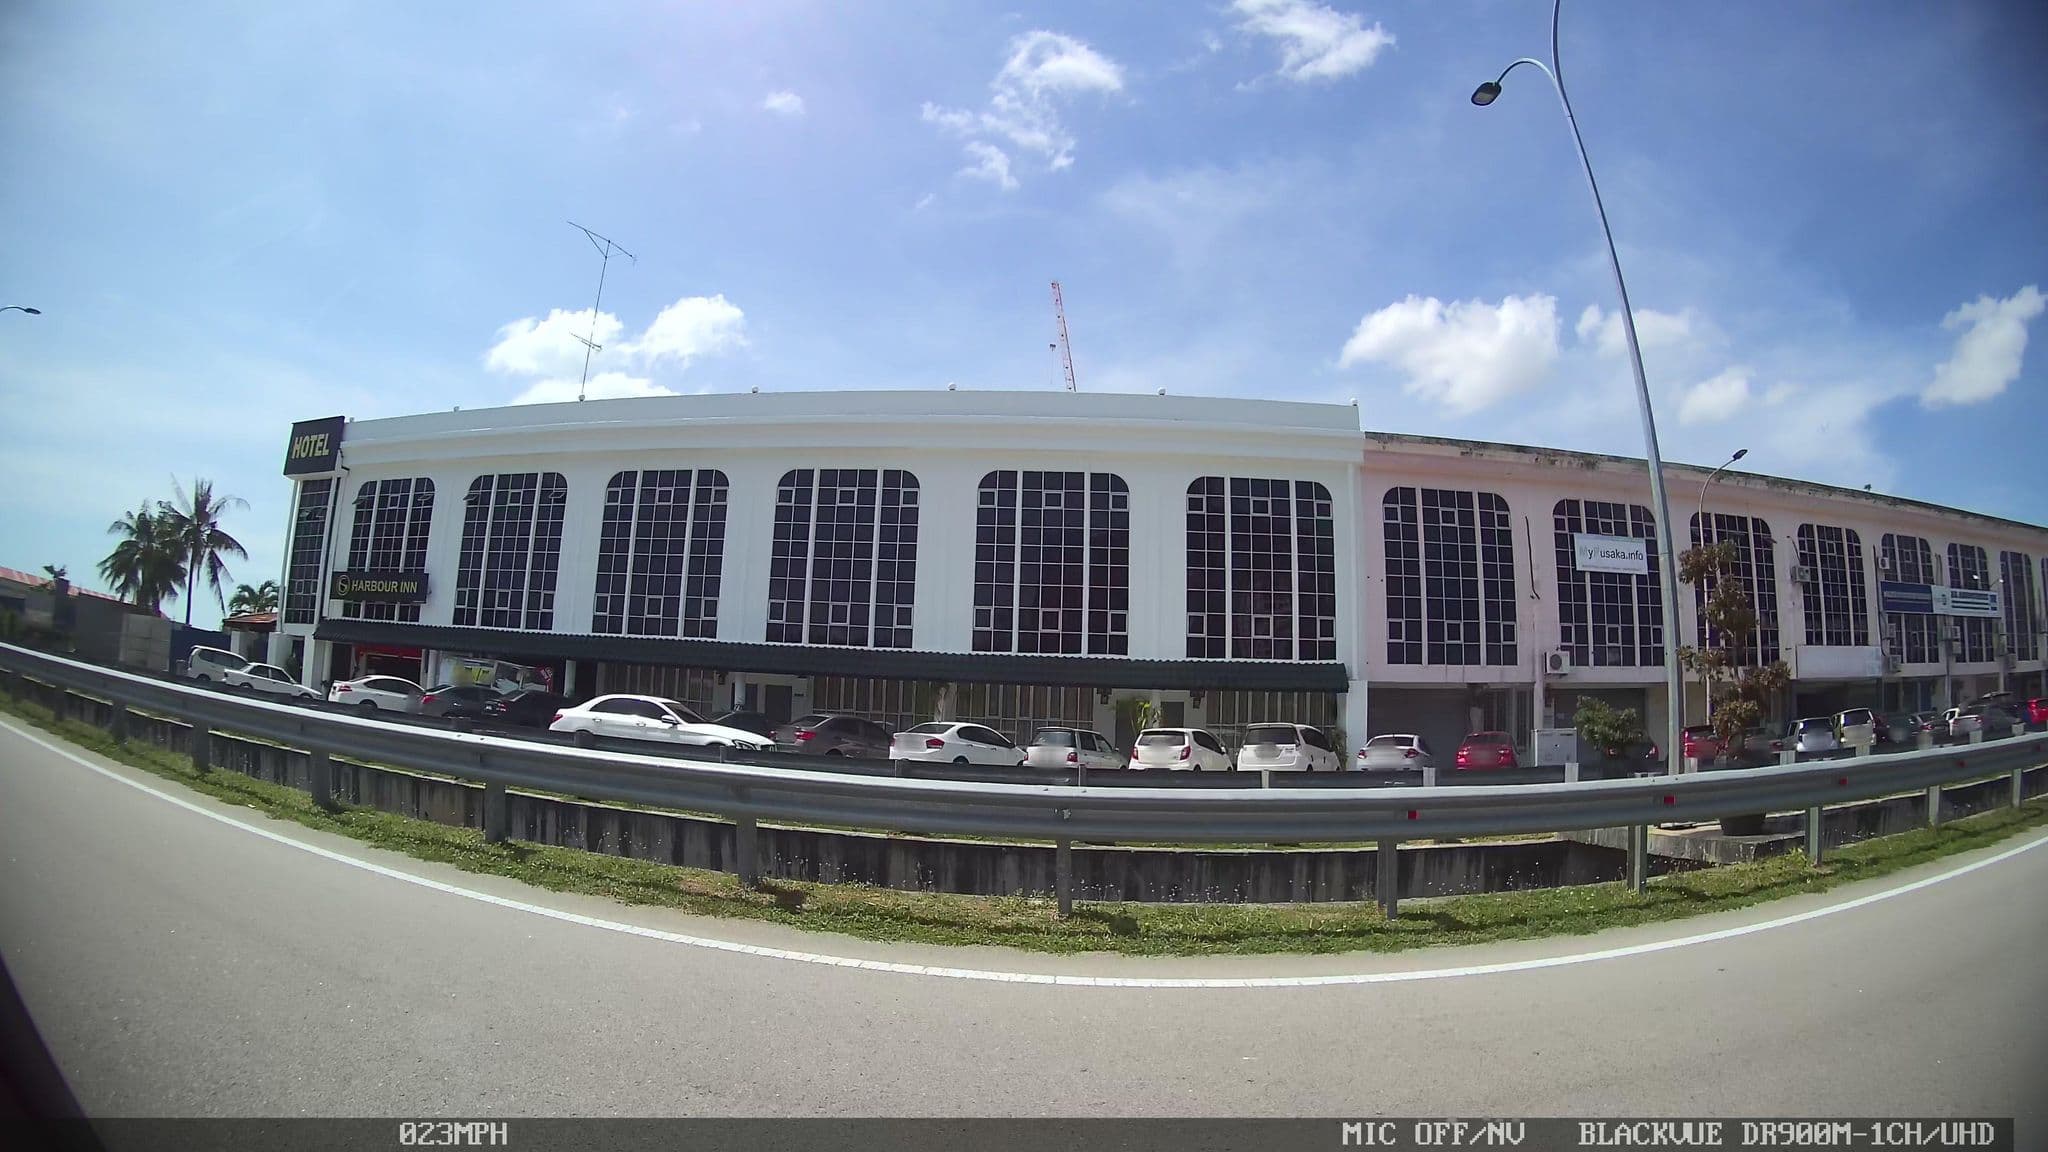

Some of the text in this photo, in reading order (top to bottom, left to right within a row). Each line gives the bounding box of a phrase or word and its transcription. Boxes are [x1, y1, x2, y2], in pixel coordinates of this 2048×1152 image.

[291, 433, 330, 459] HOTEL
[351, 579, 418, 594] HARBOUR INN
